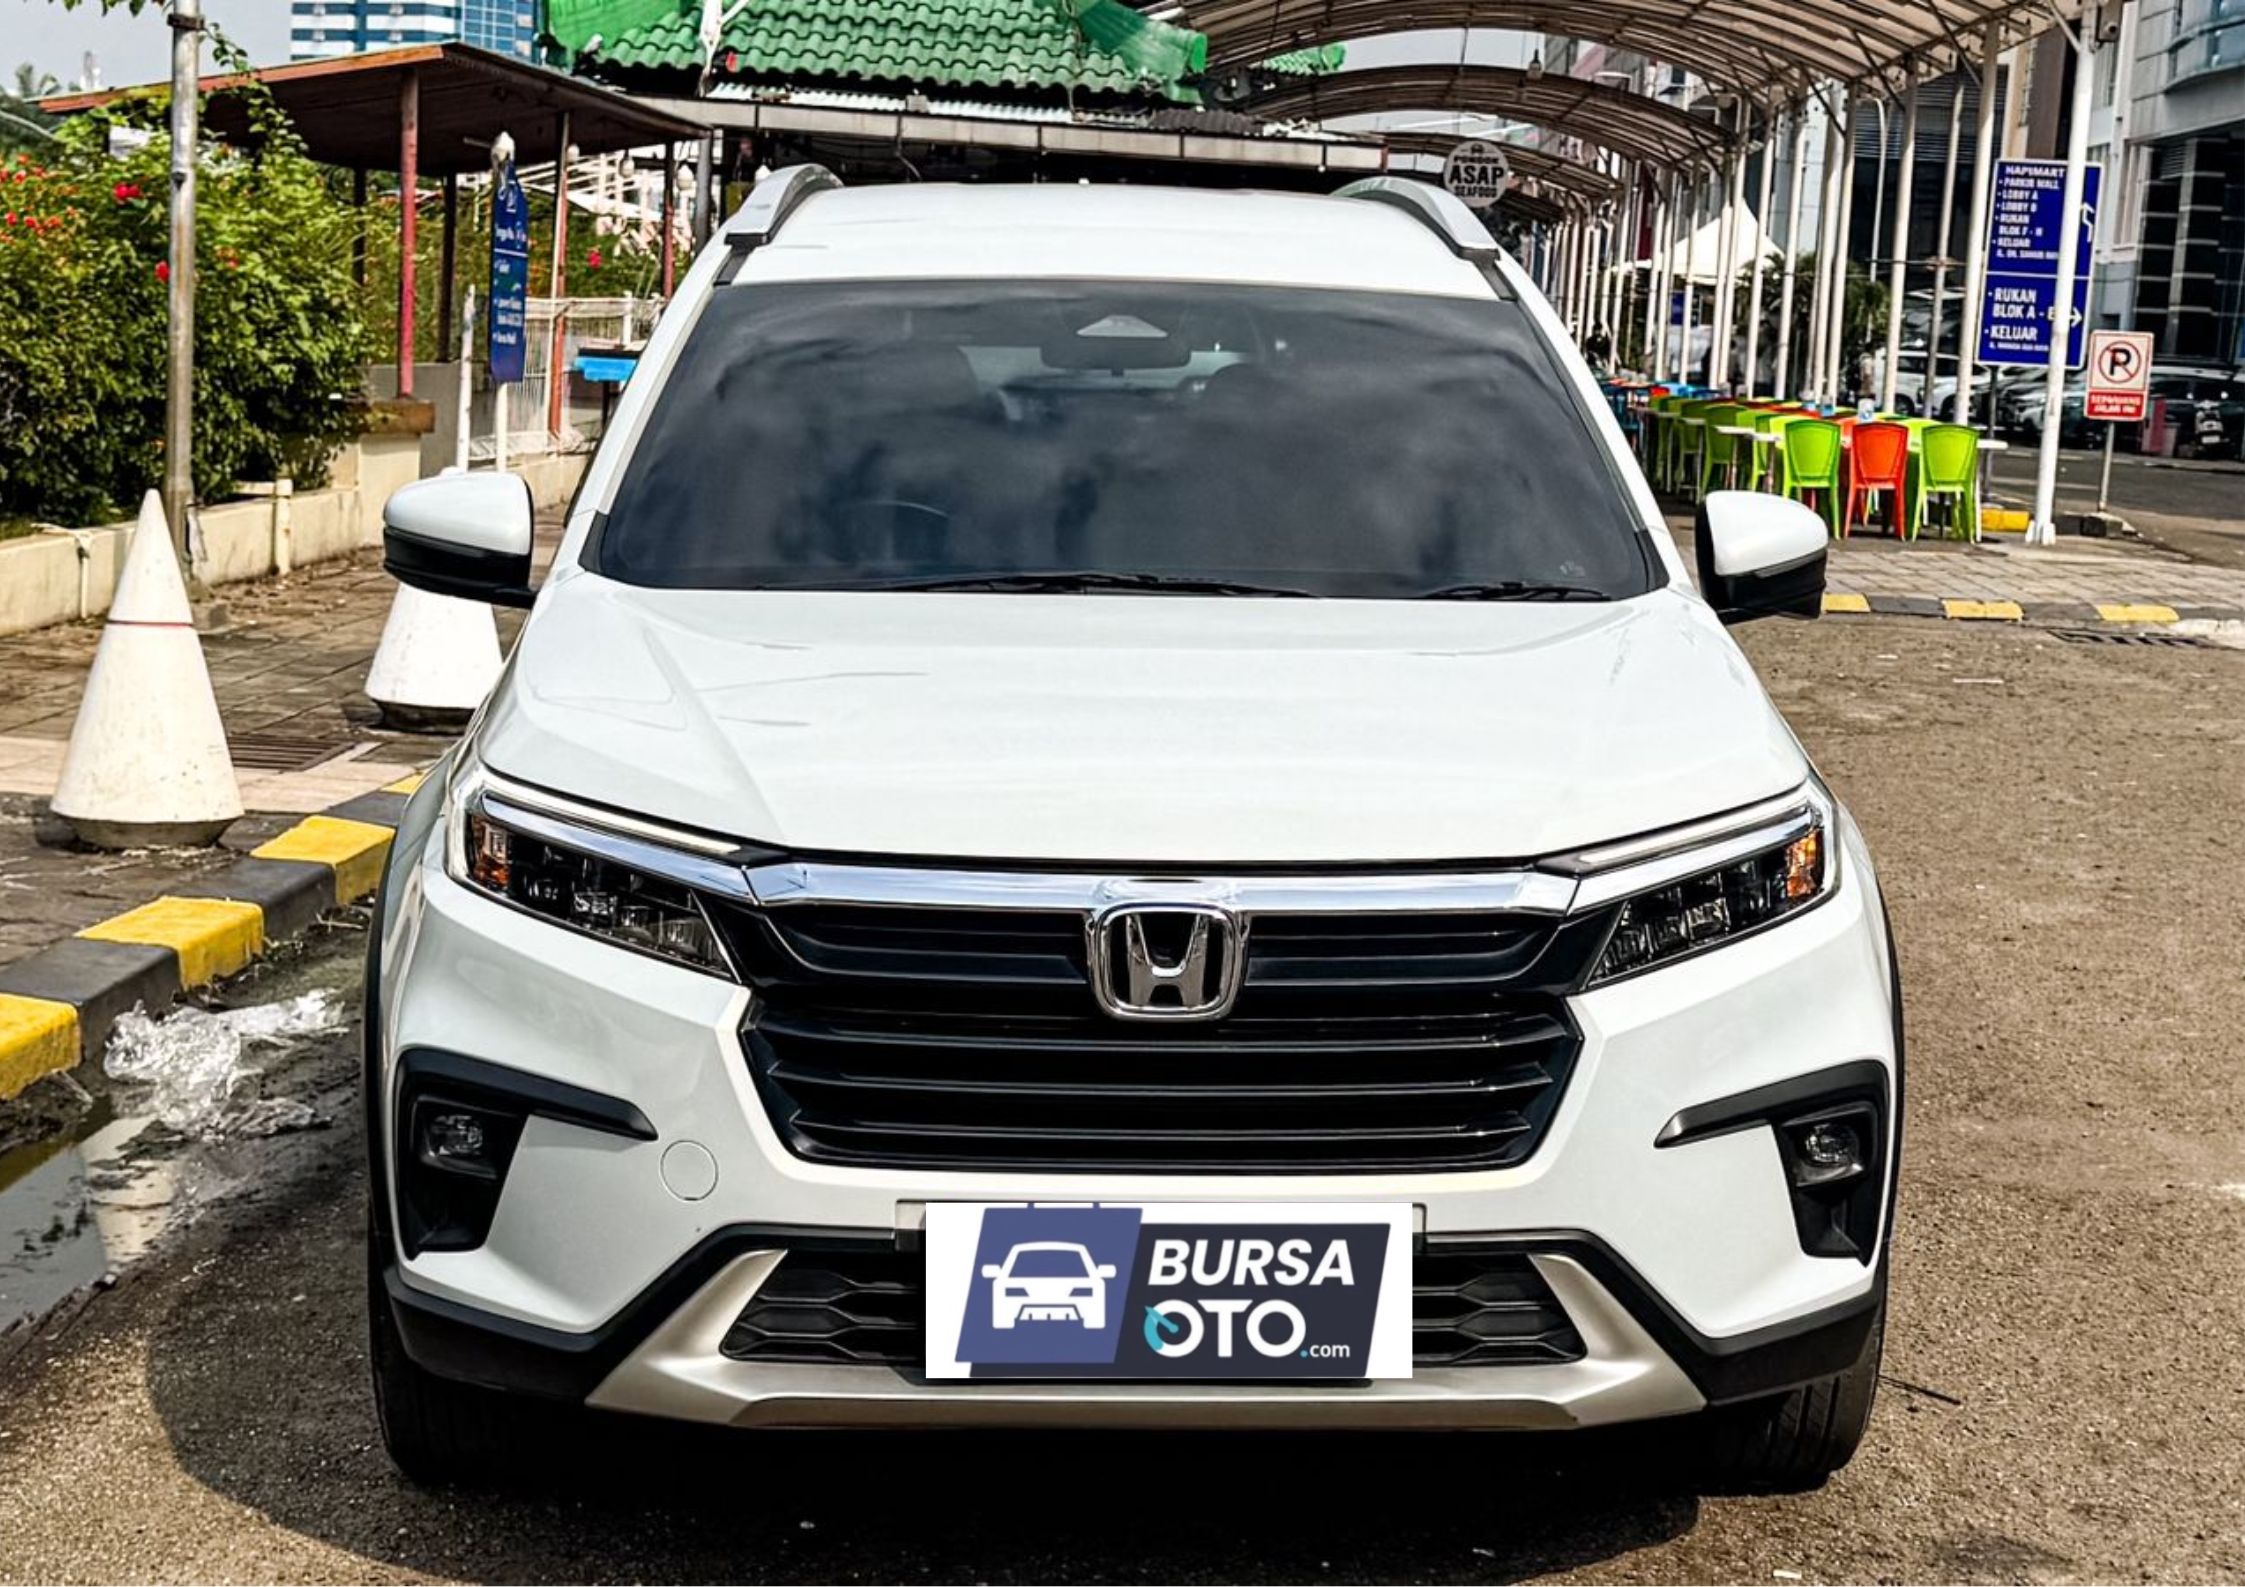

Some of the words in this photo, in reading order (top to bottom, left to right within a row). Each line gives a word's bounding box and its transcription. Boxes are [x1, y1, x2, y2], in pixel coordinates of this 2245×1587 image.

[1448, 165, 1504, 185] ASAP
[1454, 185, 1497, 198] SEAFOOD
[2002, 189, 2031, 200] LOBBY
[2031, 190, 2039, 200] A
[2001, 202, 2028, 212] LOBBY
[1994, 287, 2037, 303] RUKAN
[1992, 303, 2024, 318] BLOK
[2026, 305, 2036, 319] A
[1990, 325, 2038, 341] KELUAR
[2109, 347, 2132, 376] P
